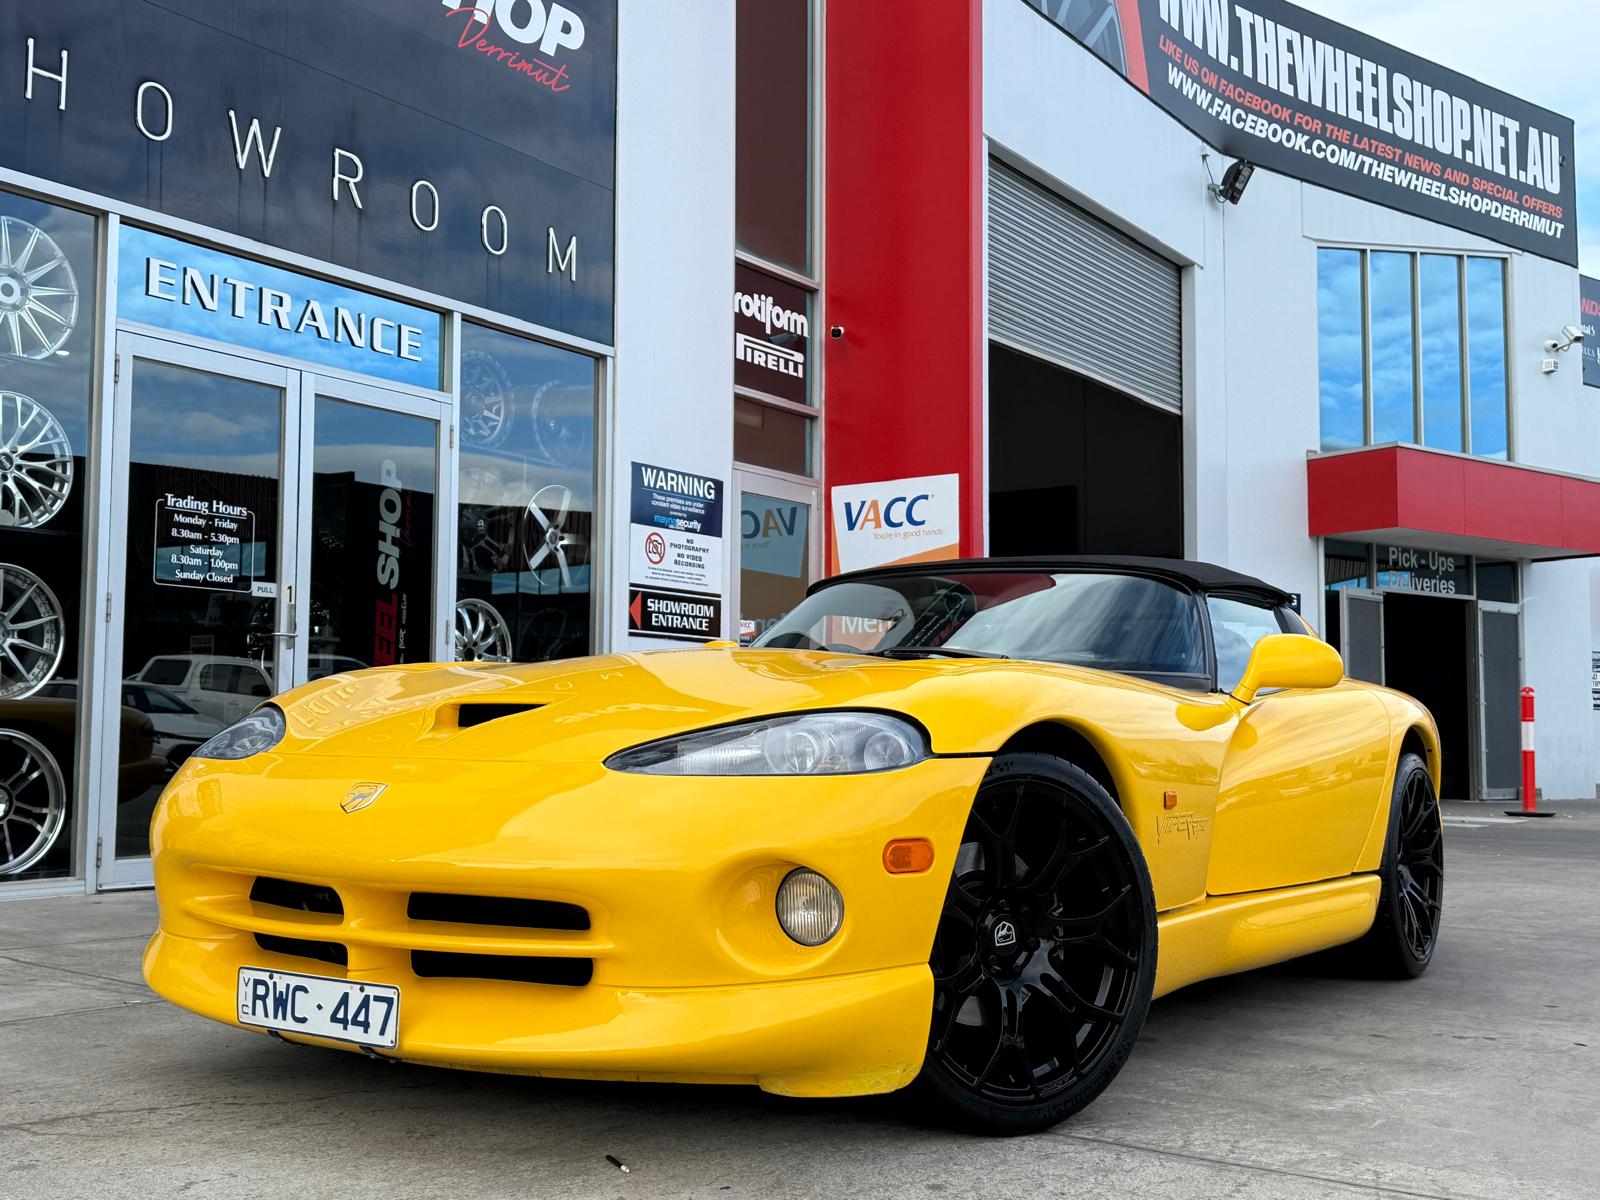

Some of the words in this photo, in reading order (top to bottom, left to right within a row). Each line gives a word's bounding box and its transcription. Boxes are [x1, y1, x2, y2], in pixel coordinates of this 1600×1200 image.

[446, 7, 571, 92] Derrimut
[1159, 34, 1183, 63] LIKE
[1184, 53, 1199, 76] US
[1201, 66, 1218, 89] ON
[1218, 77, 1293, 124] FACEBOOK
[1293, 112, 1322, 135] FOR
[1325, 123, 1351, 145] THE
[1352, 133, 1402, 163] LATEST
[1403, 152, 1442, 177] NEWS
[1443, 168, 1470, 187] AND
[1472, 176, 1520, 205] SPECIAL
[1522, 195, 1563, 219] OFFERS
[1168, 62, 1565, 239] WWW.FACEBOOK.COM/THEWHEELSHOPDERRIMUT
[145, 257, 423, 361] ENTRANCE
[734, 292, 809, 337] rotiform
[736, 332, 804, 378] PIRELLI
[641, 466, 715, 500] WARNING
[165, 493, 209, 515] Trading
[212, 500, 248, 517] Hours
[651, 500, 670, 508] constant
[682, 505, 705, 514] surveillance
[652, 492, 666, 501] These
[666, 496, 685, 506] premises
[173, 513, 206, 527] Monday
[214, 519, 238, 532] Friday
[844, 494, 930, 531] VACC
[377, 459, 402, 590] SHOP
[872, 530, 894, 540] You're
[903, 529, 921, 540] good
[922, 528, 944, 536] hands
[171, 528, 202, 540] 8.30am
[210, 533, 240, 545] 5.30pm
[189, 544, 224, 559] Saturday
[670, 542, 710, 554] PHOTOGRAPHY
[686, 553, 703, 562] VIDEO
[171, 554, 202, 566] 8.30am
[210, 559, 238, 571] 1.00pm
[673, 558, 705, 570] RECORDING
[1389, 546, 1418, 568] Pick
[1428, 550, 1455, 575] Ups
[175, 569, 204, 583] Sunday
[206, 571, 234, 583] Closed
[1389, 570, 1455, 594] Deliveries
[257, 585, 273, 594] PULL
[647, 598, 714, 618] SHOWROOM
[374, 591, 398, 667] EEL
[651, 613, 709, 631] ENTRANCE
[251, 978, 310, 1024] RWC
[330, 991, 395, 1036] 447
